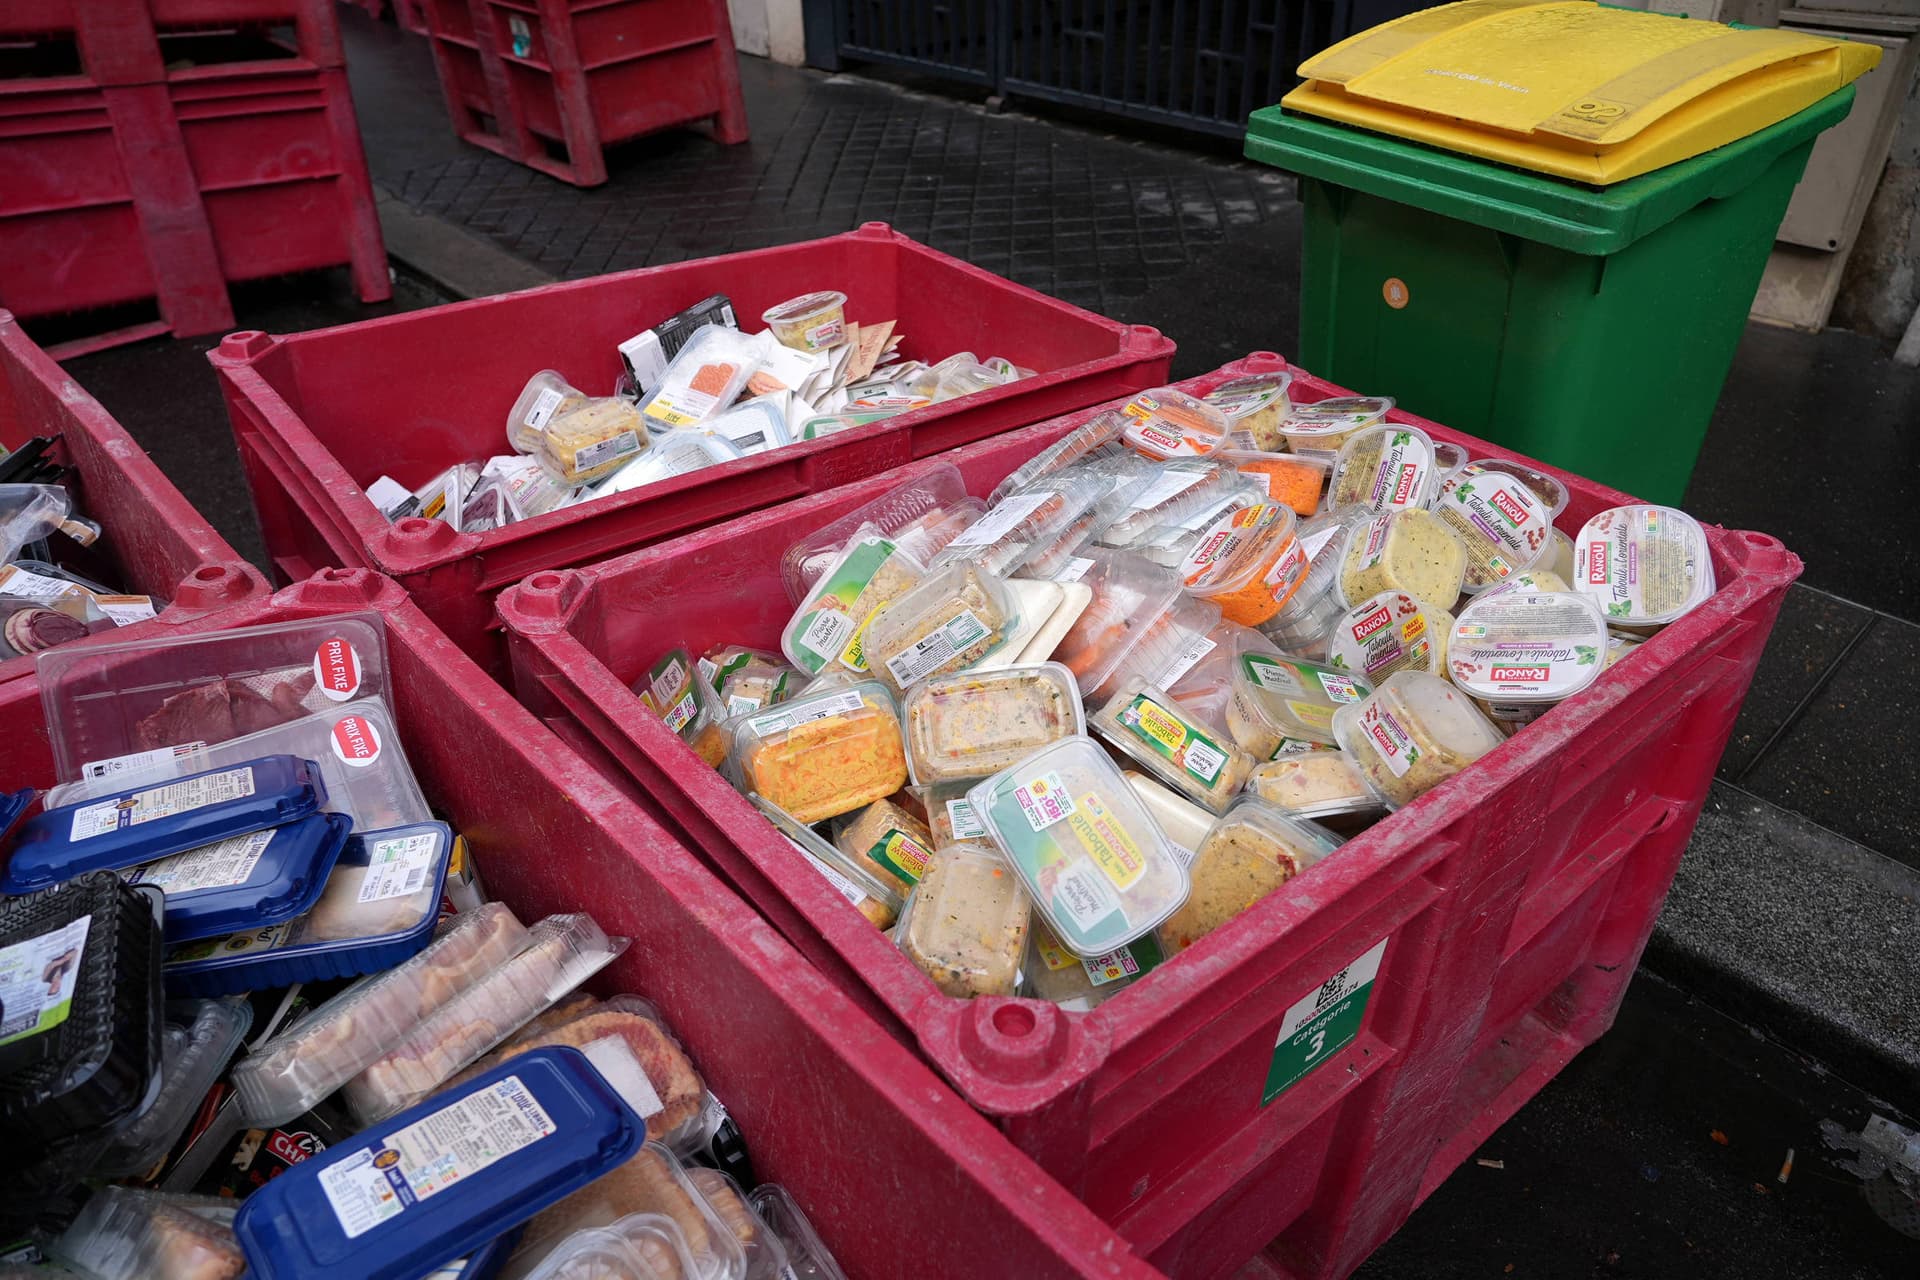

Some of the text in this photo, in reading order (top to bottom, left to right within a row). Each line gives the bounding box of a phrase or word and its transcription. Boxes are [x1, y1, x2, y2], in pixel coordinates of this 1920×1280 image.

[1395, 466, 1415, 502] RANOU
[1494, 493, 1525, 522] RANOU
[1467, 494, 1493, 521] Taboulé
[1490, 519, 1523, 551] l'orientale
[1614, 523, 1629, 563] l'orientale
[1591, 544, 1605, 582] RANOU
[1612, 569, 1629, 601] Taboulé
[811, 616, 831, 638] Pierre
[1355, 611, 1388, 638] RANOU
[1404, 622, 1424, 639] FORMAT
[1405, 618, 1420, 631] MAXI
[1363, 630, 1393, 654] Taboulé
[1366, 637, 1399, 666] l'orientale
[1471, 648, 1523, 662] l'orientale
[1531, 648, 1575, 662] Taboulé
[328, 641, 348, 689] PRIX FIXE
[1495, 669, 1545, 680] RANOU
[1145, 717, 1175, 744] Taboulé
[1149, 711, 1174, 731] POULET
[342, 718, 369, 758] PRIX FIXE
[1374, 726, 1395, 755] RANOU
[1072, 815, 1113, 866] Taboulé
[1096, 822, 1138, 871] AU POULET
[891, 846, 924, 873] oleslaw
[1064, 885, 1088, 914] Pierre
[1293, 1000, 1352, 1047] Catégorie
[1304, 1030, 1326, 1062] 3
[511, 1090, 549, 1130] Loué LIBRES
